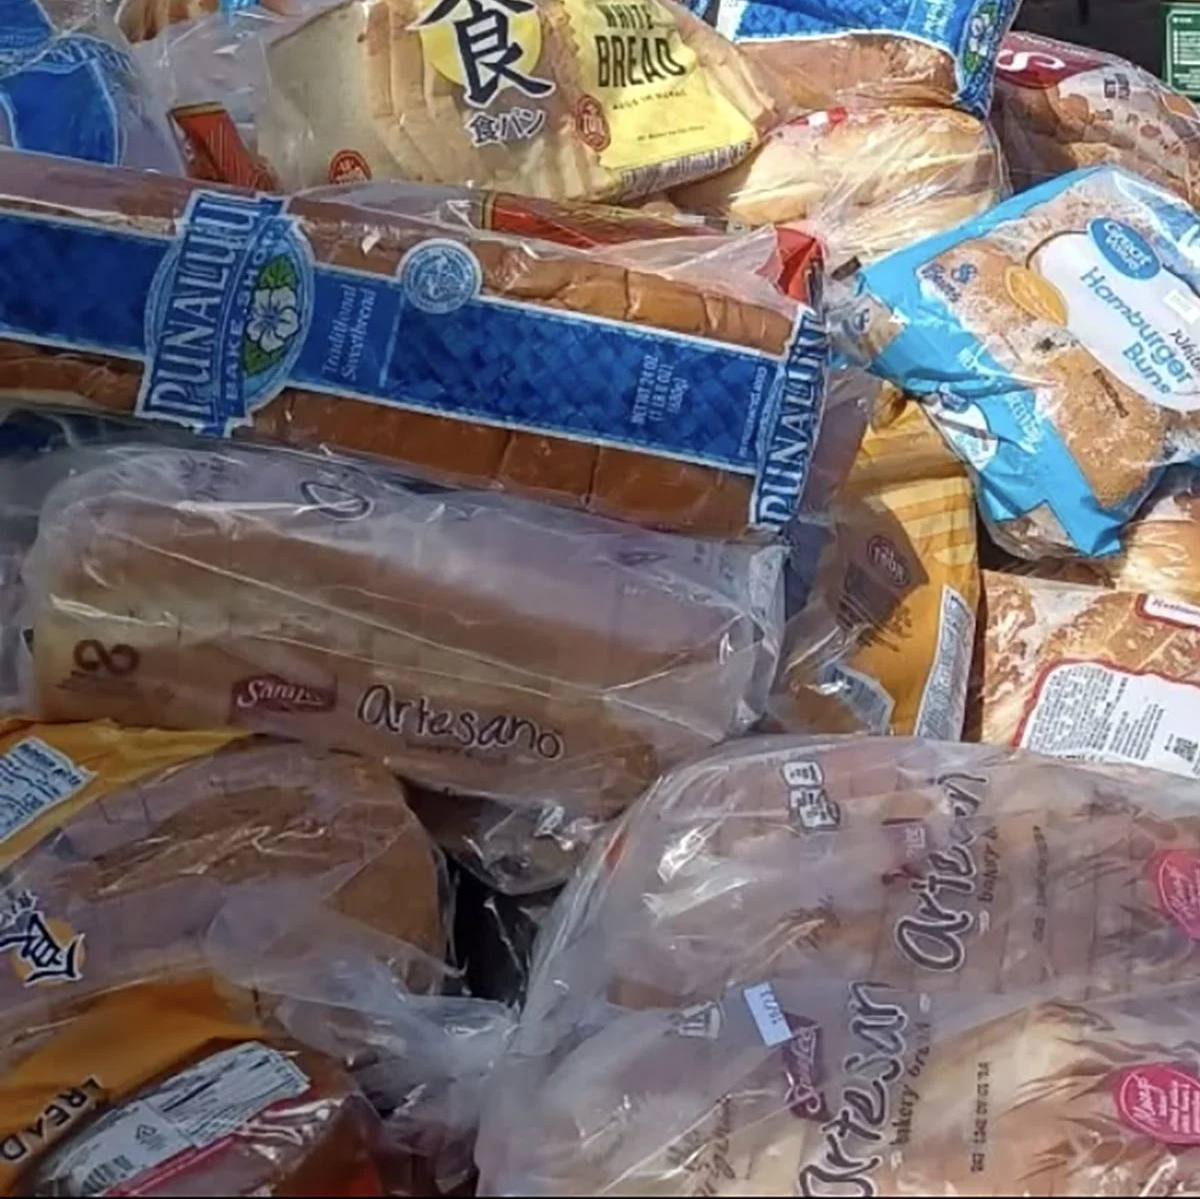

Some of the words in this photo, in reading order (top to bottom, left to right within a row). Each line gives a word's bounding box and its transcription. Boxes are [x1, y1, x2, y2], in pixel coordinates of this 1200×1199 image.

[597, 4, 654, 30] WHITE
[595, 35, 686, 88] BREAD
[466, 106, 545, 147] 食パン
[1104, 221, 1151, 266] Great
[1079, 266, 1194, 384] Hamburger
[225, 318, 245, 401] BAKE
[1122, 341, 1173, 395] Buns
